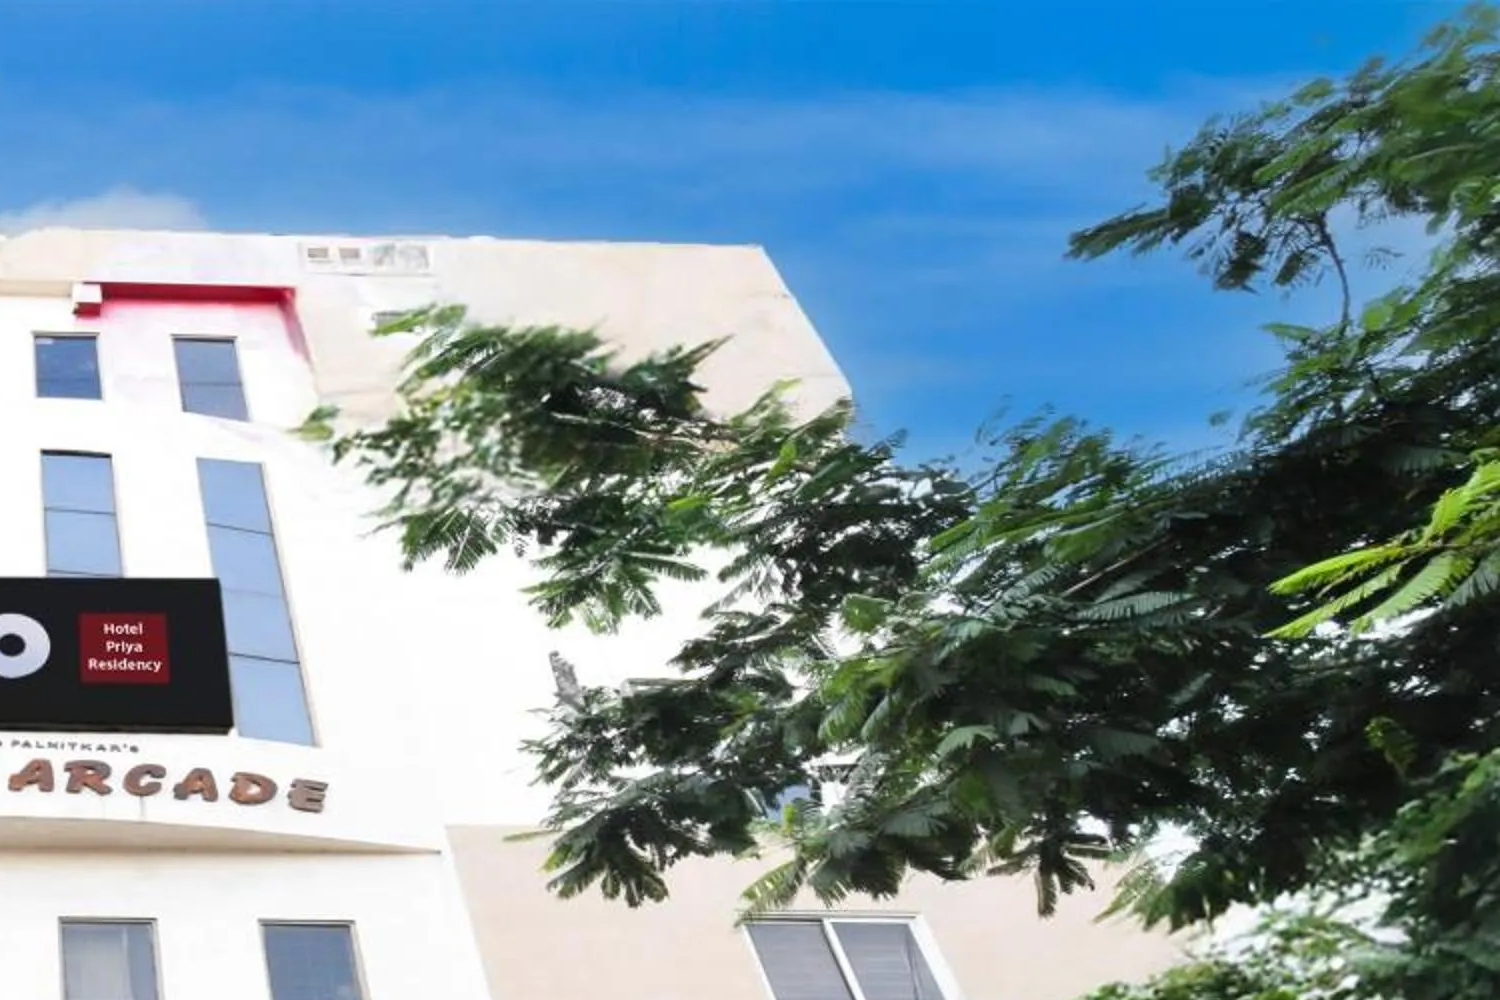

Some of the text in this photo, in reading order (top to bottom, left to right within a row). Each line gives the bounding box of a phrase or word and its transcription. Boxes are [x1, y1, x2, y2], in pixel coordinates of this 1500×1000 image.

[103, 621, 144, 635] Hotel
[105, 640, 143, 655] Priya
[87, 657, 162, 673] Residency
[8, 758, 330, 812] ARCADE
